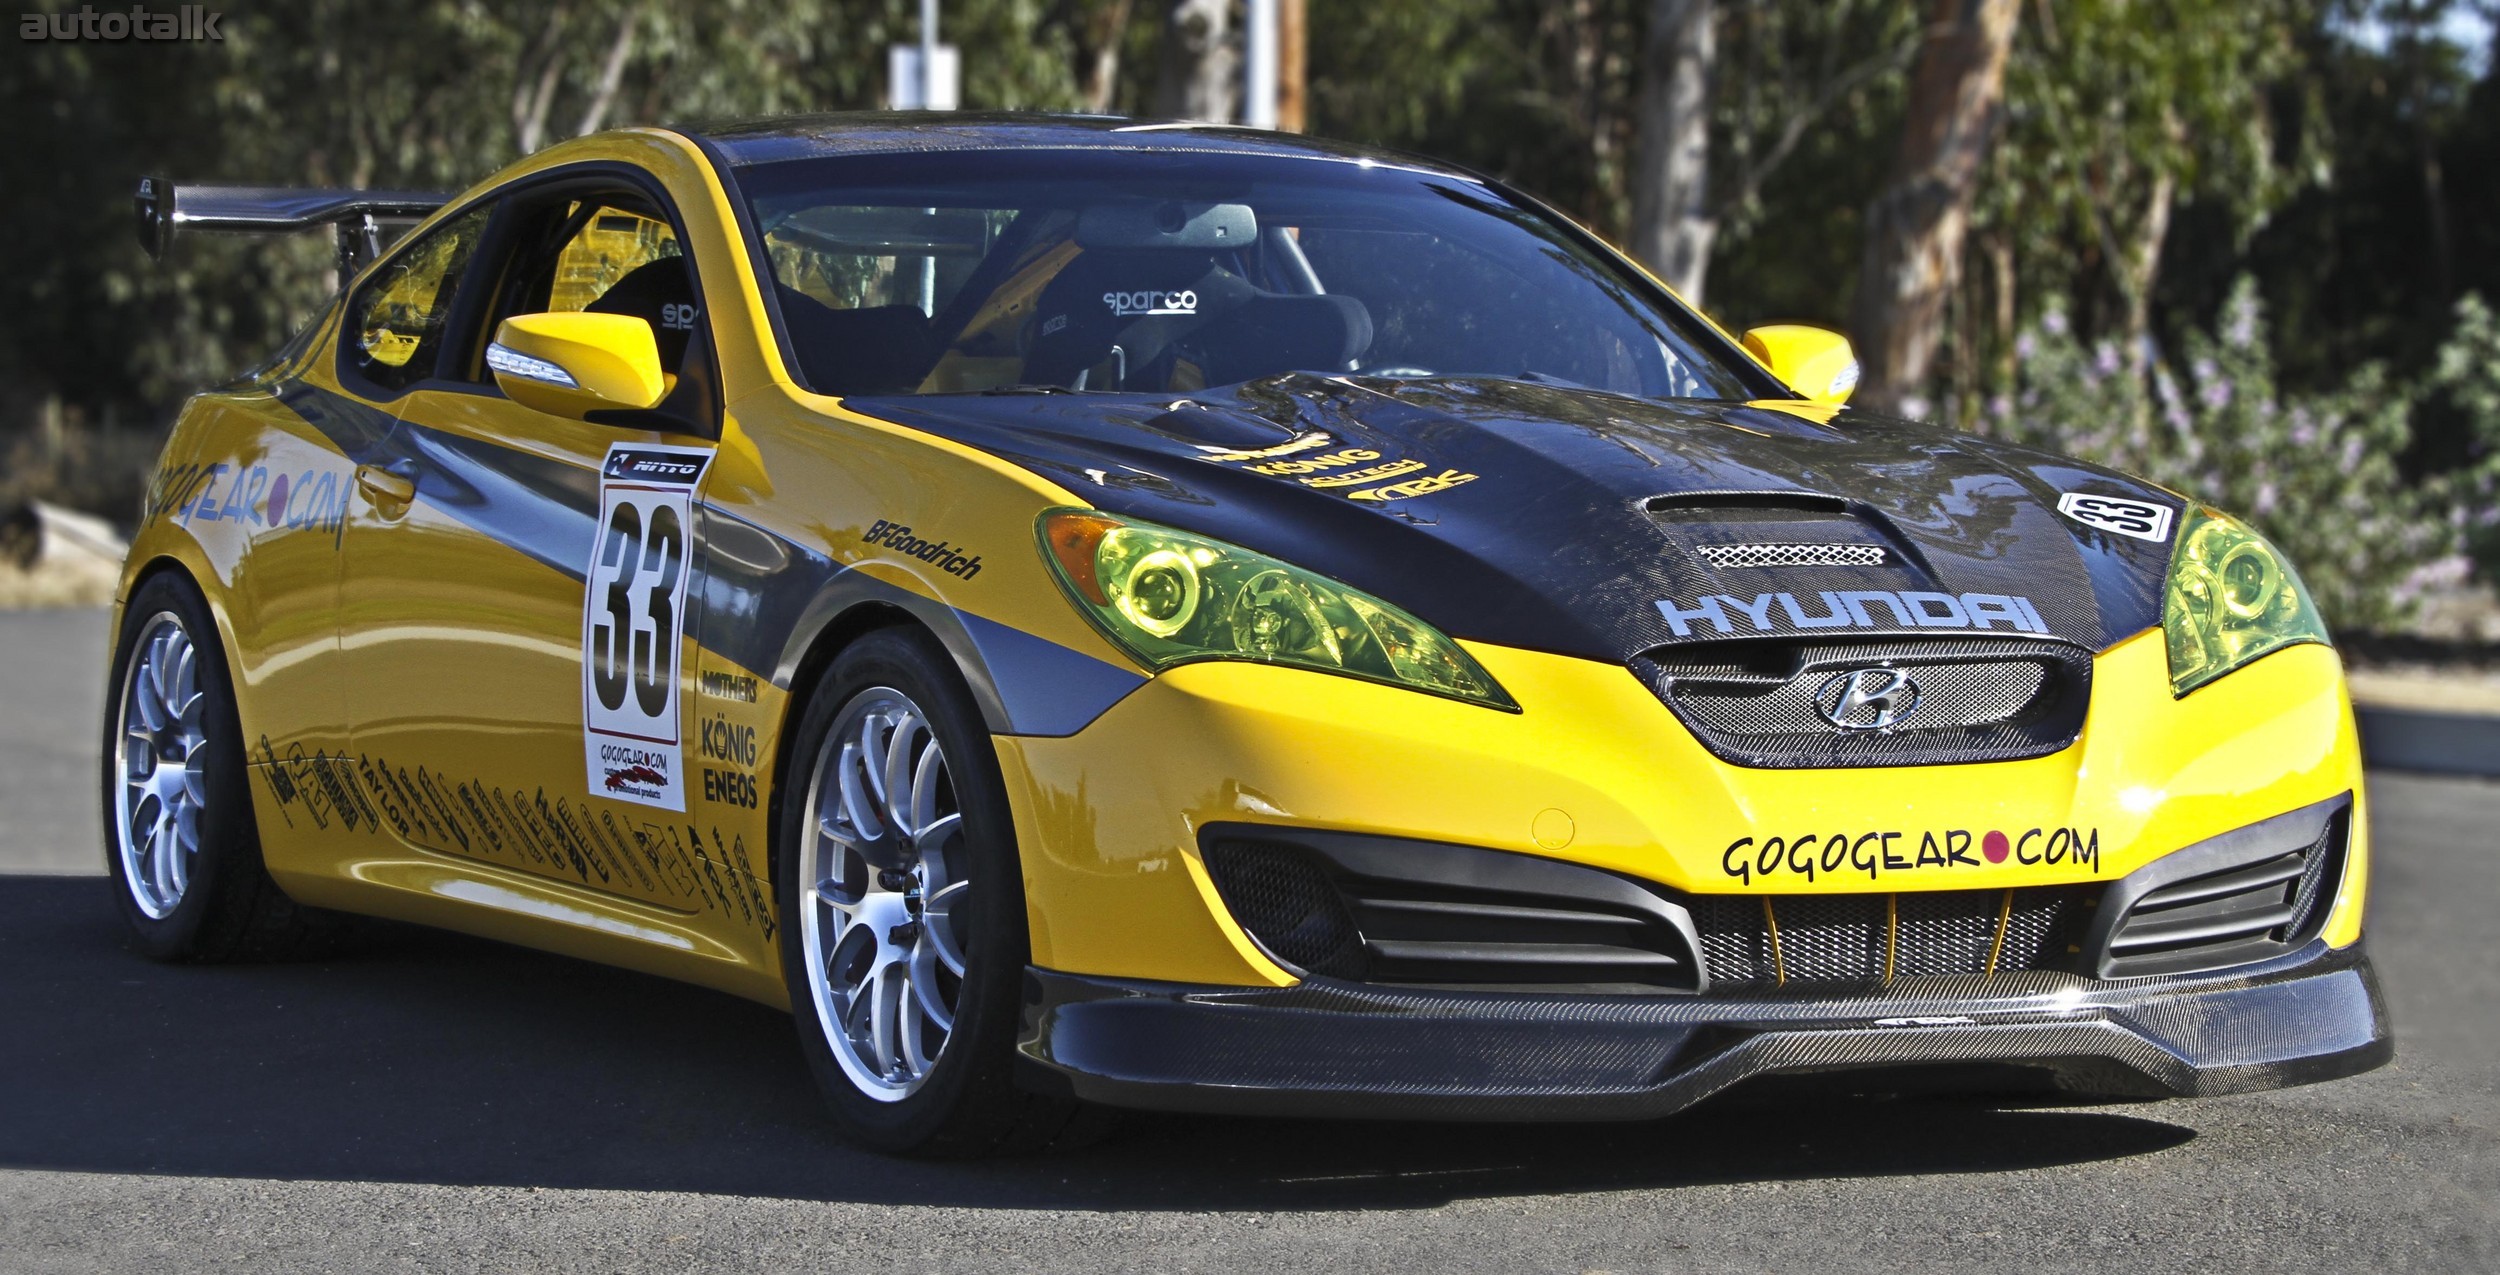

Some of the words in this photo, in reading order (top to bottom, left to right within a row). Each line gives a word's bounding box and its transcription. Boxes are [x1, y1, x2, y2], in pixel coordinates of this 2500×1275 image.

[1103, 290, 1198, 317] sparco
[633, 460, 698, 475] NITTO
[2072, 499, 2156, 533] 33
[861, 519, 982, 581] BFGoodrich
[593, 502, 683, 718] 33
[1655, 591, 2050, 637] HYUNDAI
[702, 670, 758, 704] MOTHERS
[702, 712, 757, 767] KÖNIG
[359, 752, 409, 838] TAYLOR
[703, 768, 757, 810] ENEOS
[515, 791, 564, 869] SPEC
[558, 797, 607, 878] MOROSO
[642, 822, 694, 897] AEM
